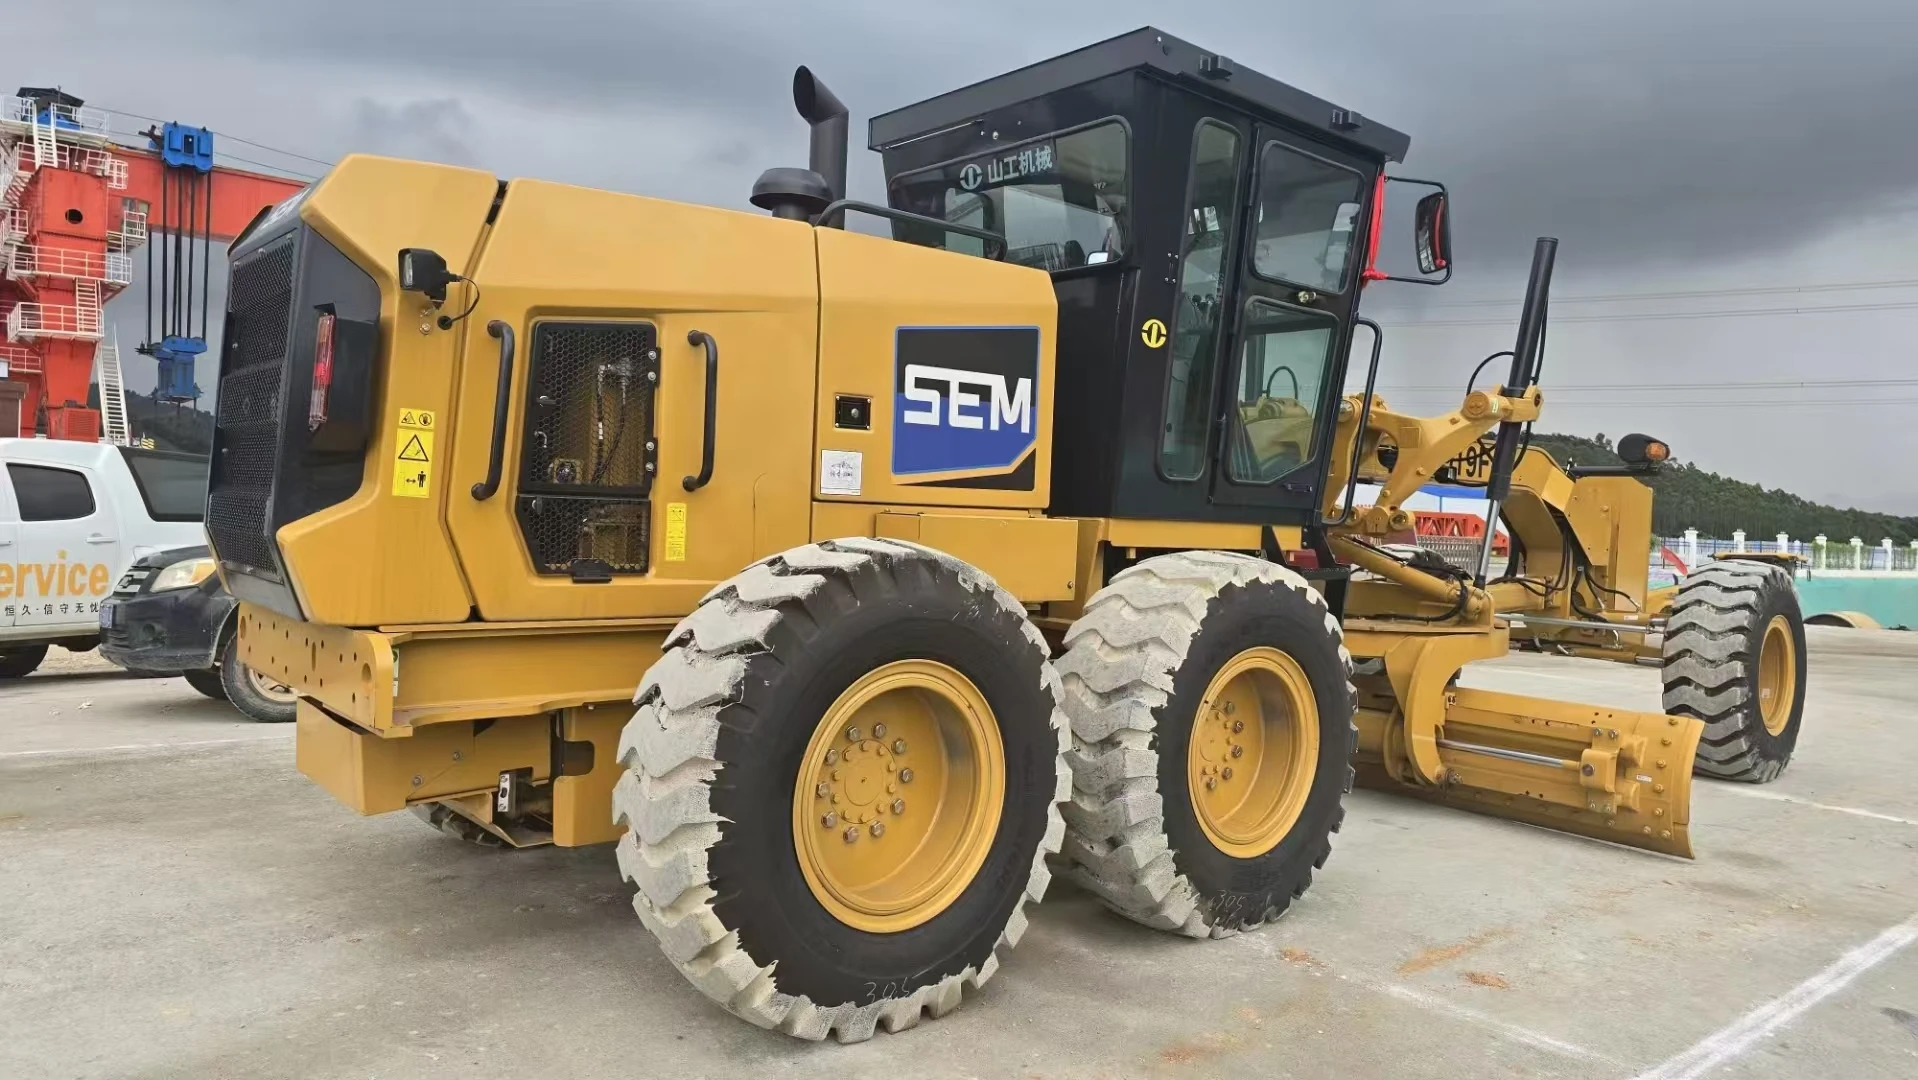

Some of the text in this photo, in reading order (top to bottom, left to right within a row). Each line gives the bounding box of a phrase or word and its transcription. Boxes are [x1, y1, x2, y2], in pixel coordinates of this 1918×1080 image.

[987, 145, 1053, 184] 山工机械
[904, 363, 1031, 433] SEM
[0, 548, 109, 599] ervice
